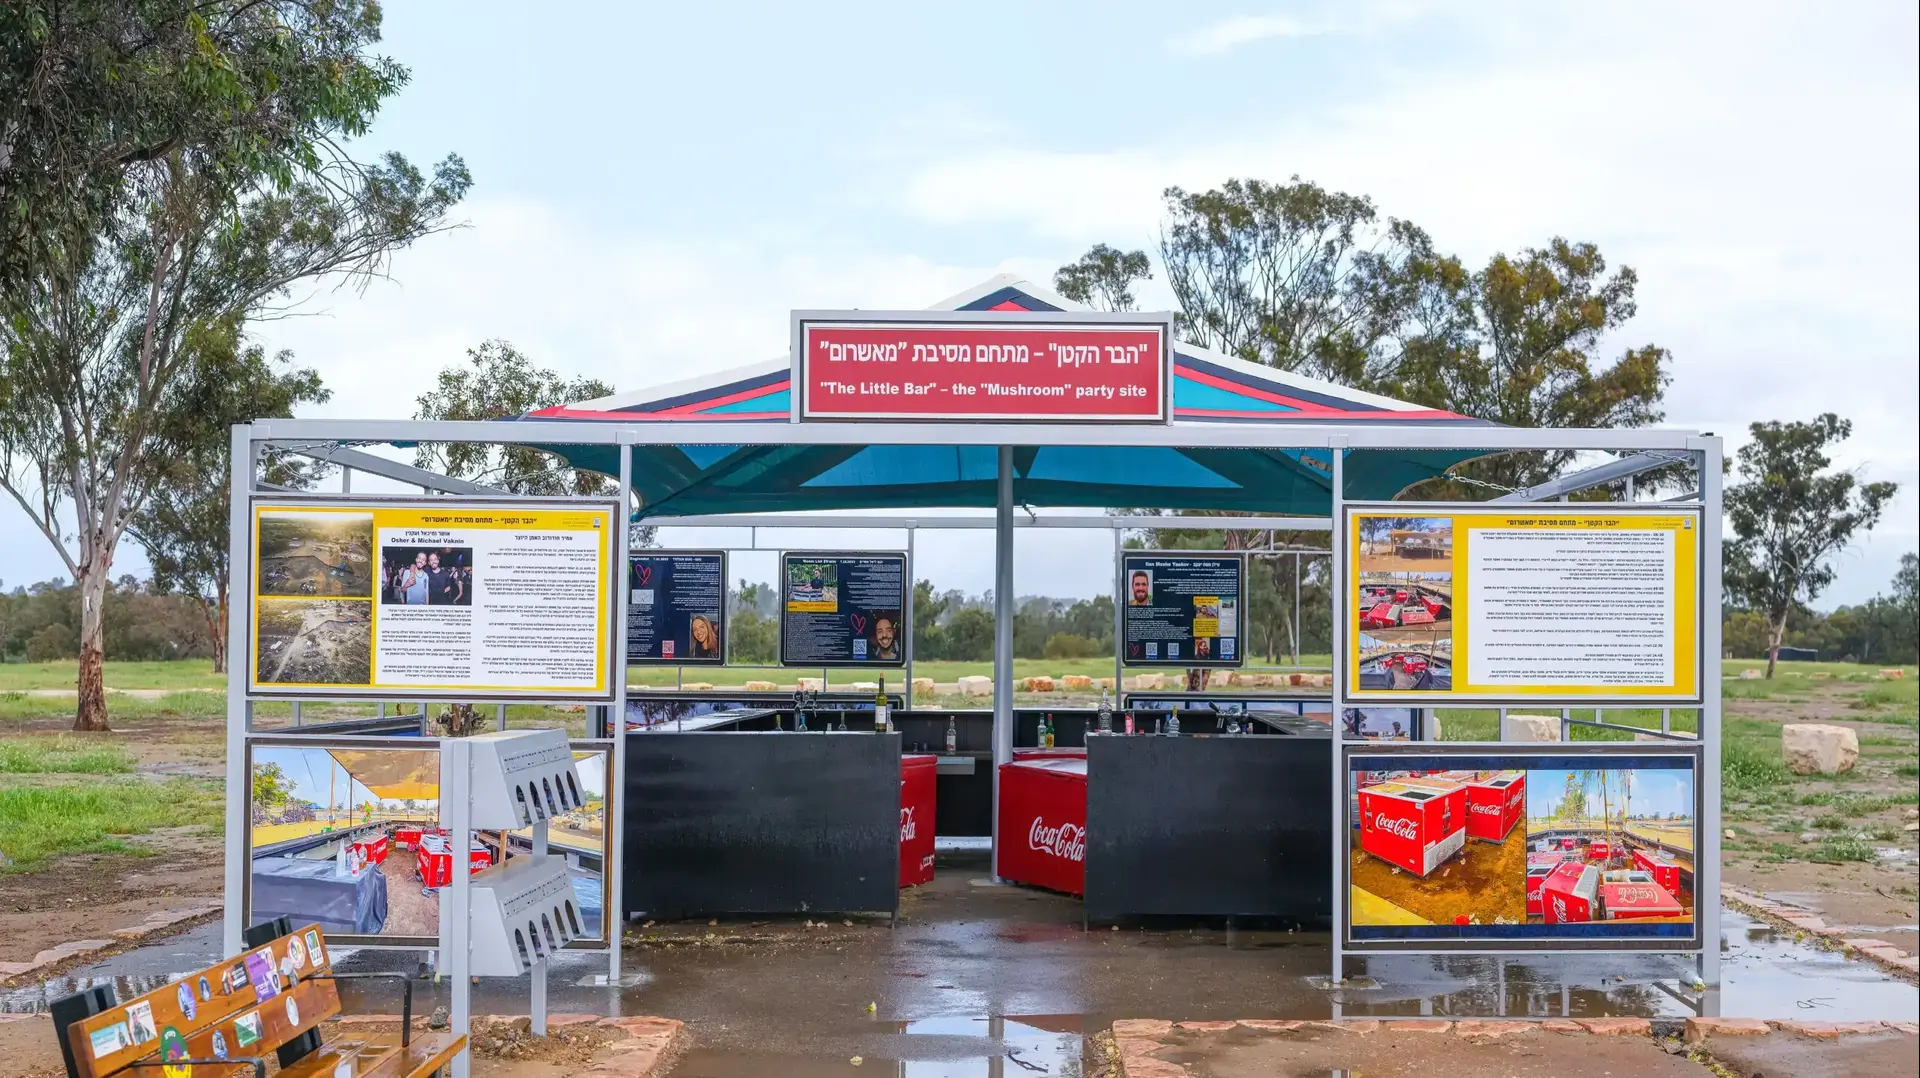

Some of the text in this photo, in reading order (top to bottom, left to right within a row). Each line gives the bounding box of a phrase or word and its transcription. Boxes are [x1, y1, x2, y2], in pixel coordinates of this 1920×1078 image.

[911, 344, 971, 363] מסיבת
[975, 344, 1029, 363] מתחם
[1048, 342, 1100, 368] הקטן"
[1104, 342, 1148, 364] "הבר
[820, 381, 856, 395] "The
[860, 381, 900, 395] Little
[904, 381, 937, 395] Bar"
[951, 382, 977, 396] the
[980, 383, 1072, 397] "Mushroom"
[1075, 384, 1115, 400] party
[1119, 384, 1147, 397] site
